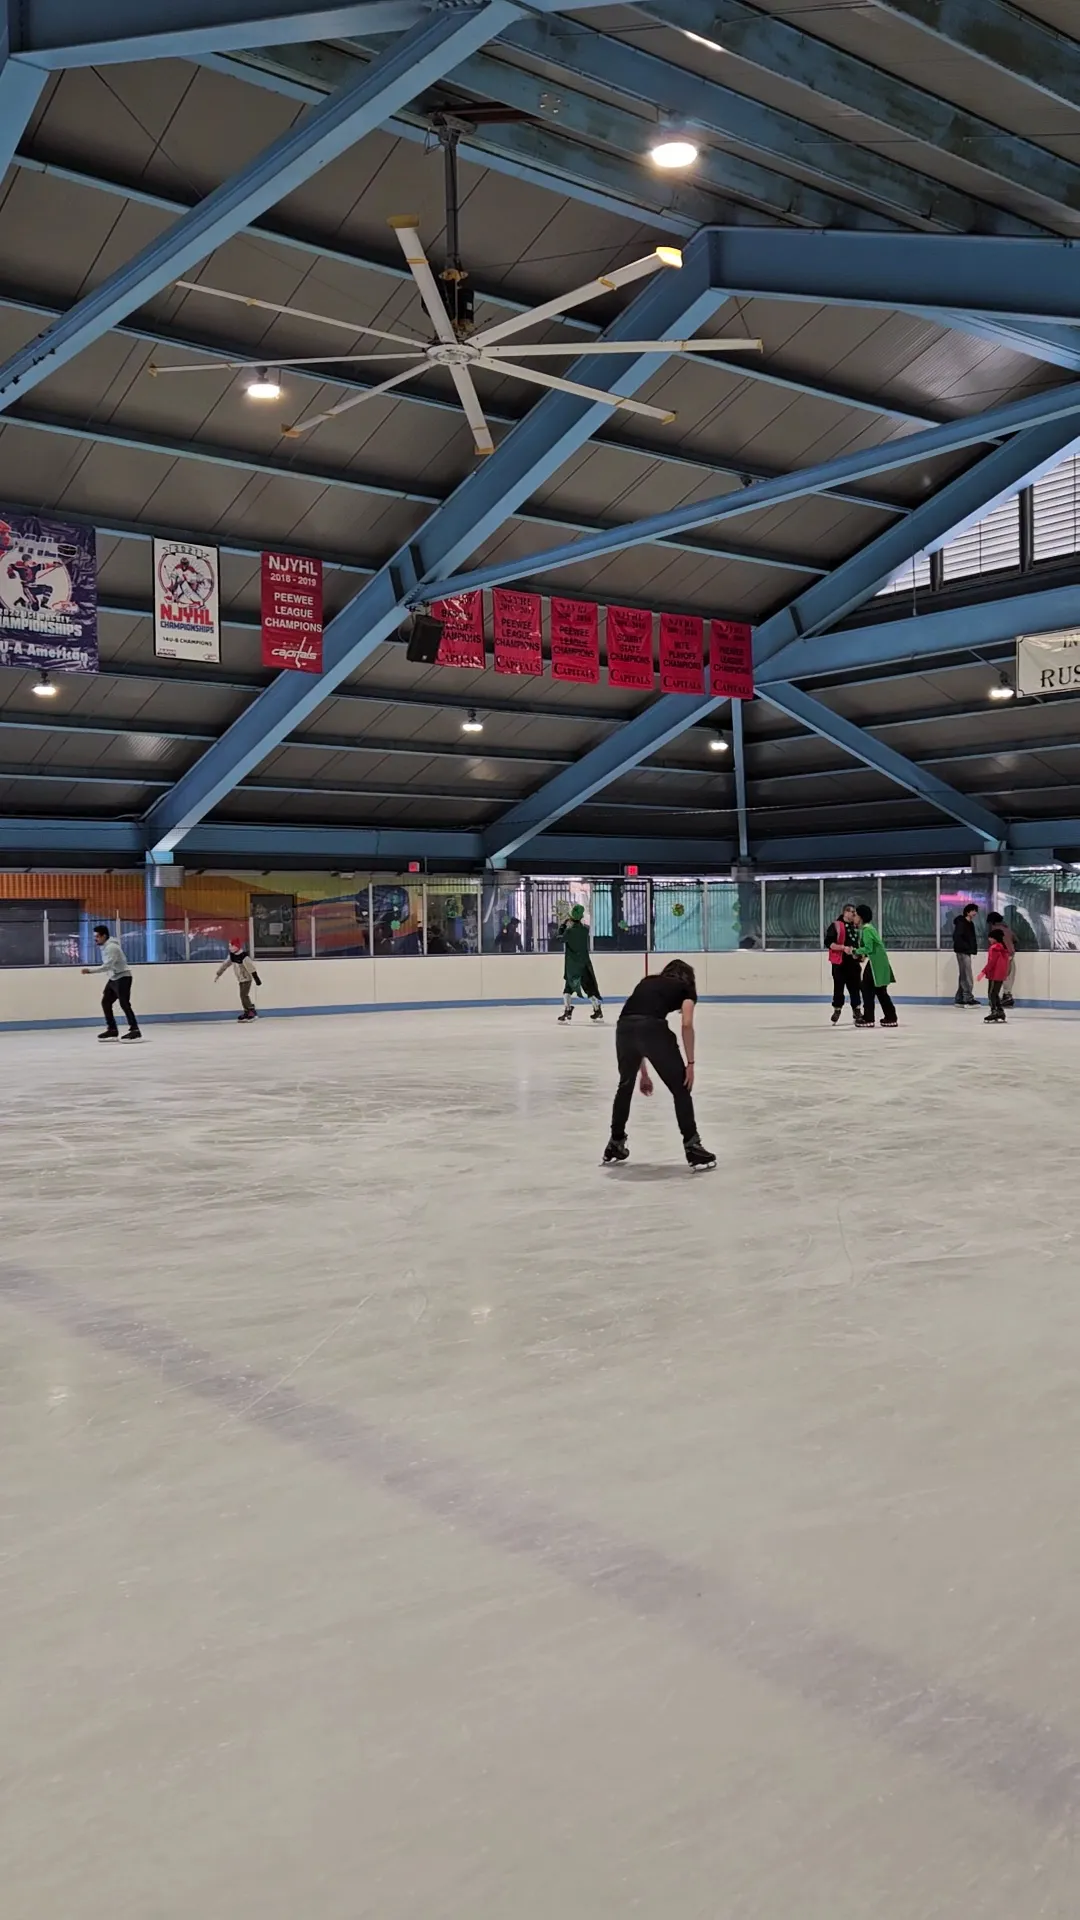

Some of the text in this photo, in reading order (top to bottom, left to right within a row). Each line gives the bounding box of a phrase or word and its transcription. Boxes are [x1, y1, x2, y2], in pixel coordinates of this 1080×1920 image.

[268, 556, 318, 575] NJYHL
[270, 572, 291, 583] 2018
[298, 576, 317, 587] 2019
[274, 592, 314, 606] PEEWEE
[160, 603, 214, 626] NJYHL
[275, 605, 313, 619] LEAGUE
[0, 615, 83, 637] AMPIONSHIPS
[160, 621, 215, 634] CHAMPIONSHIPS
[265, 617, 322, 633] CHAMPIONS
[502, 619, 532, 630] PEEWEE
[443, 631, 481, 644] HAMPIONS
